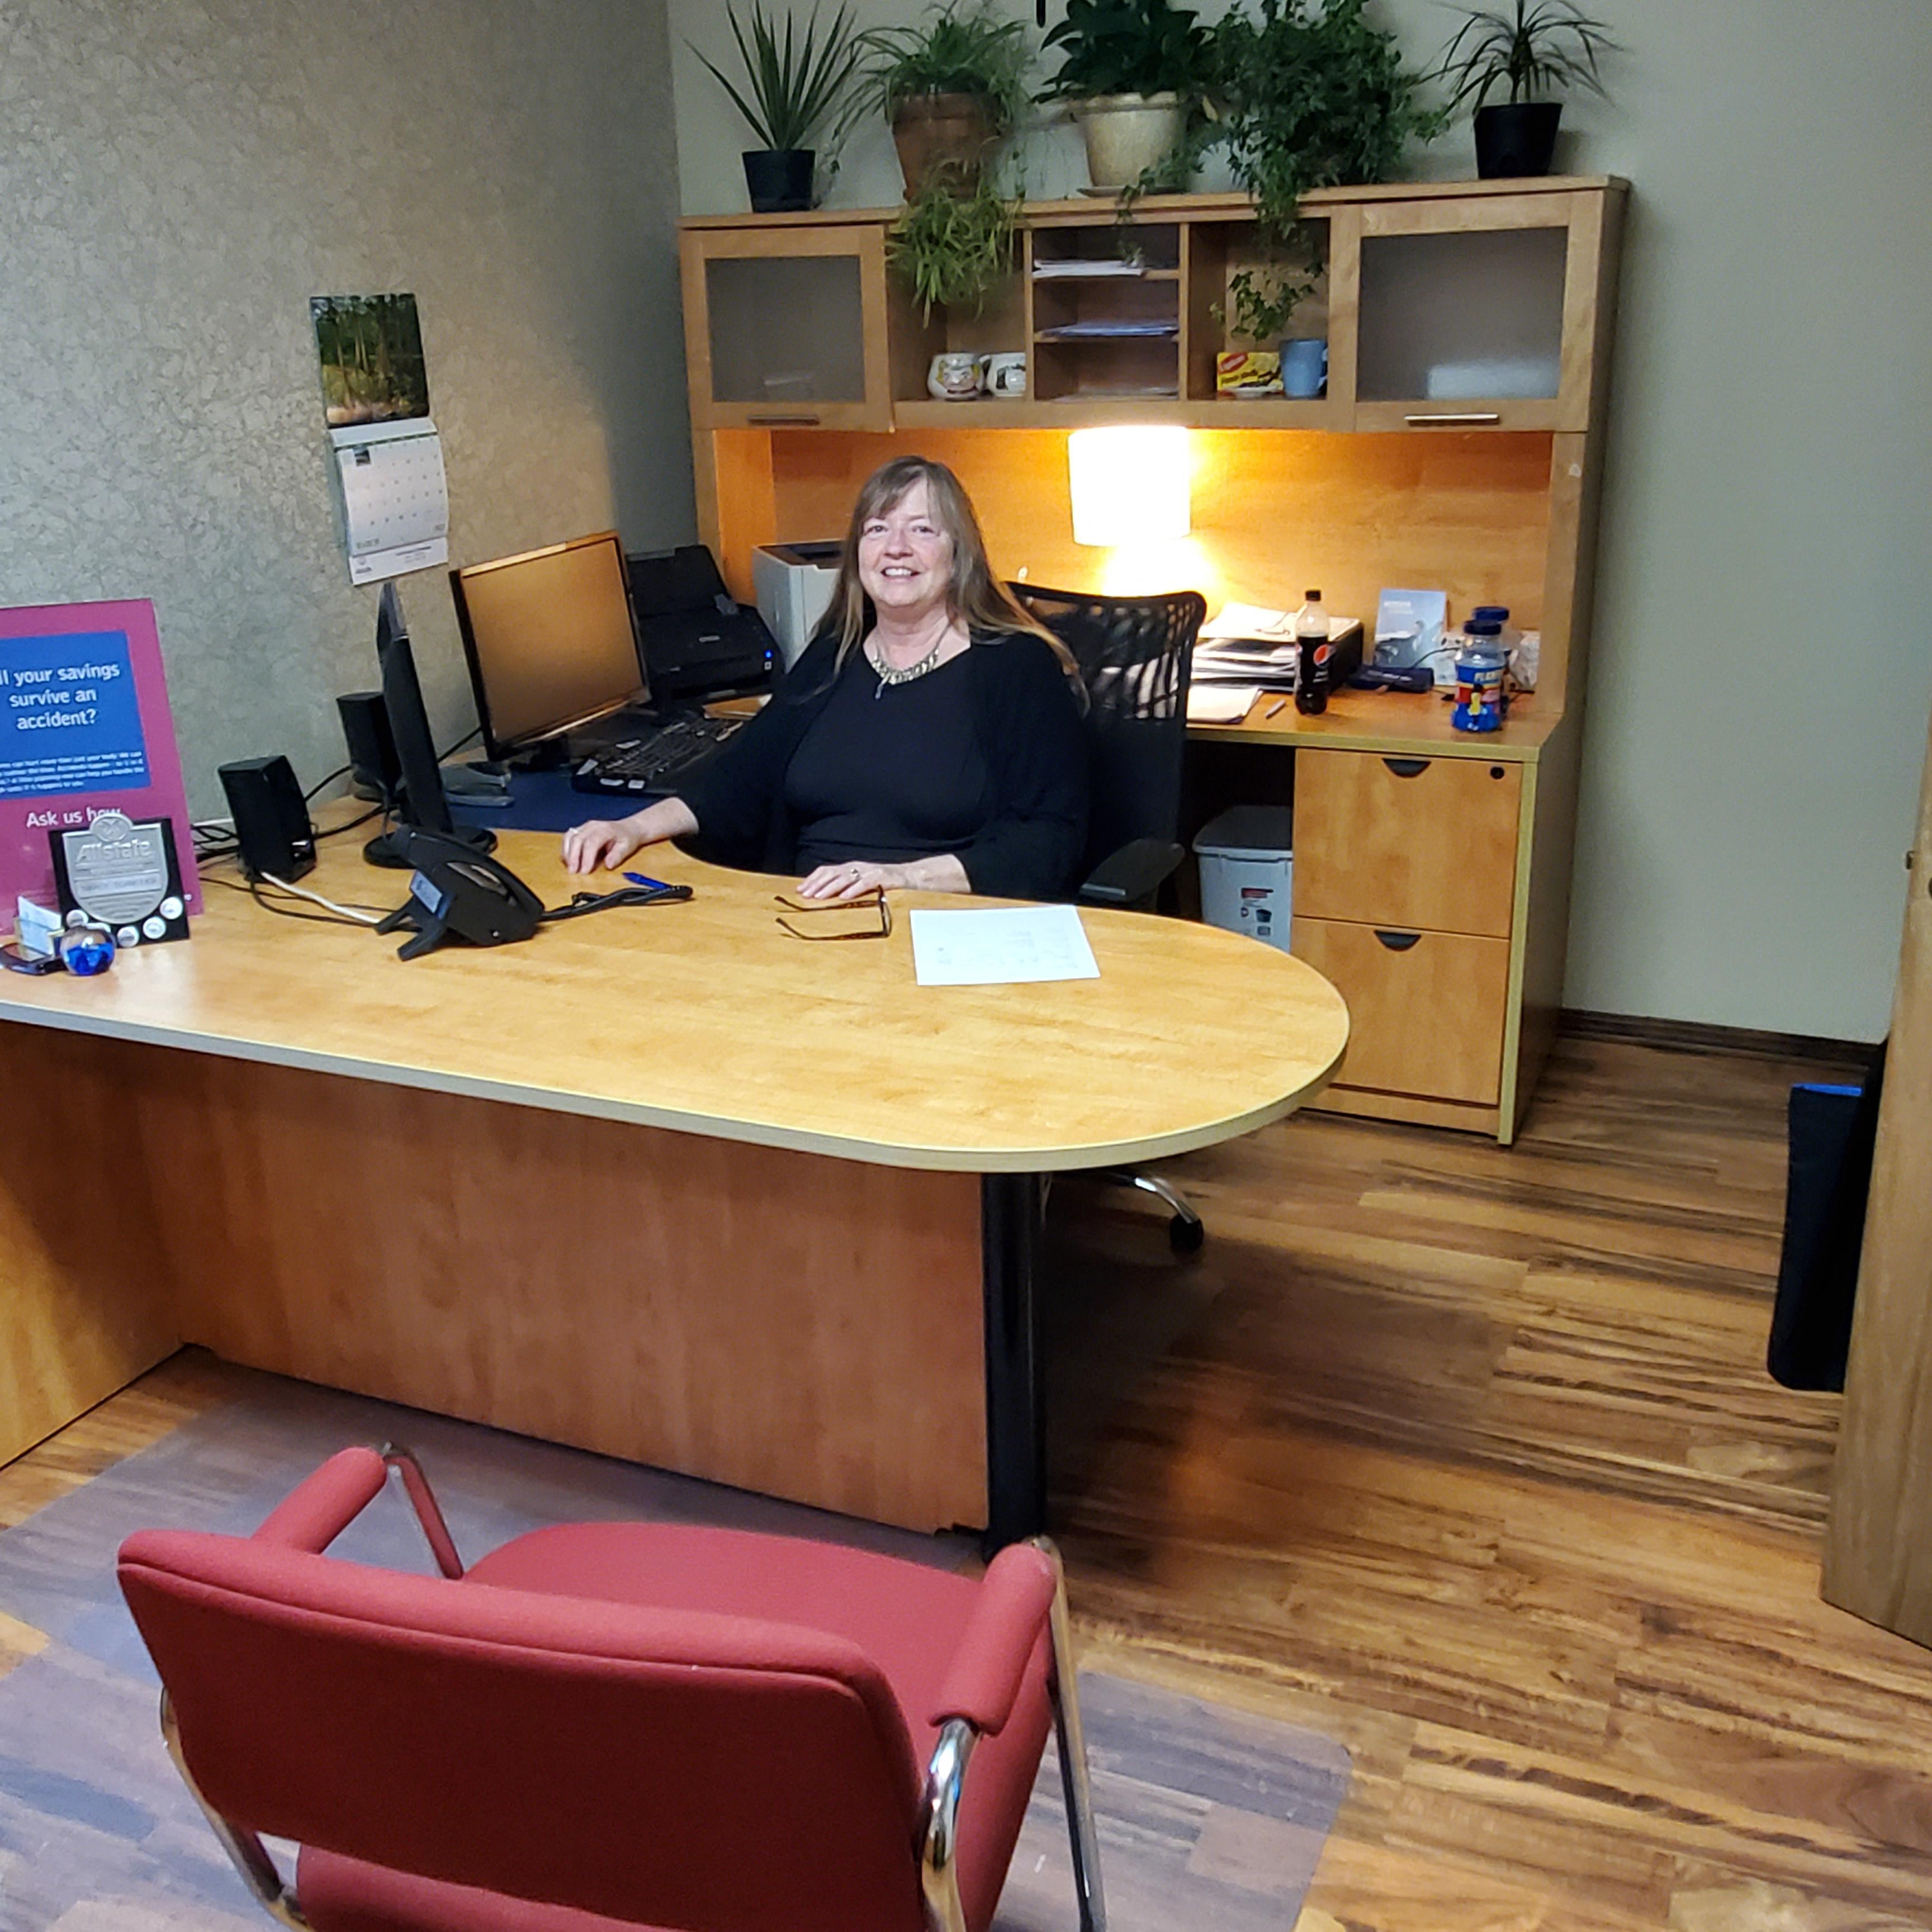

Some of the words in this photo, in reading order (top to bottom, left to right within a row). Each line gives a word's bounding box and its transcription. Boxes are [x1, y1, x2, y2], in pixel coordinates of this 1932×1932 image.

[13, 670, 53, 687] your
[57, 663, 120, 681] savings
[9, 689, 70, 708] survive
[75, 689, 97, 702] an
[16, 708, 97, 730] accident?
[26, 811, 58, 828] Ask
[63, 811, 83, 824] us
[75, 839, 153, 863] Allstate
